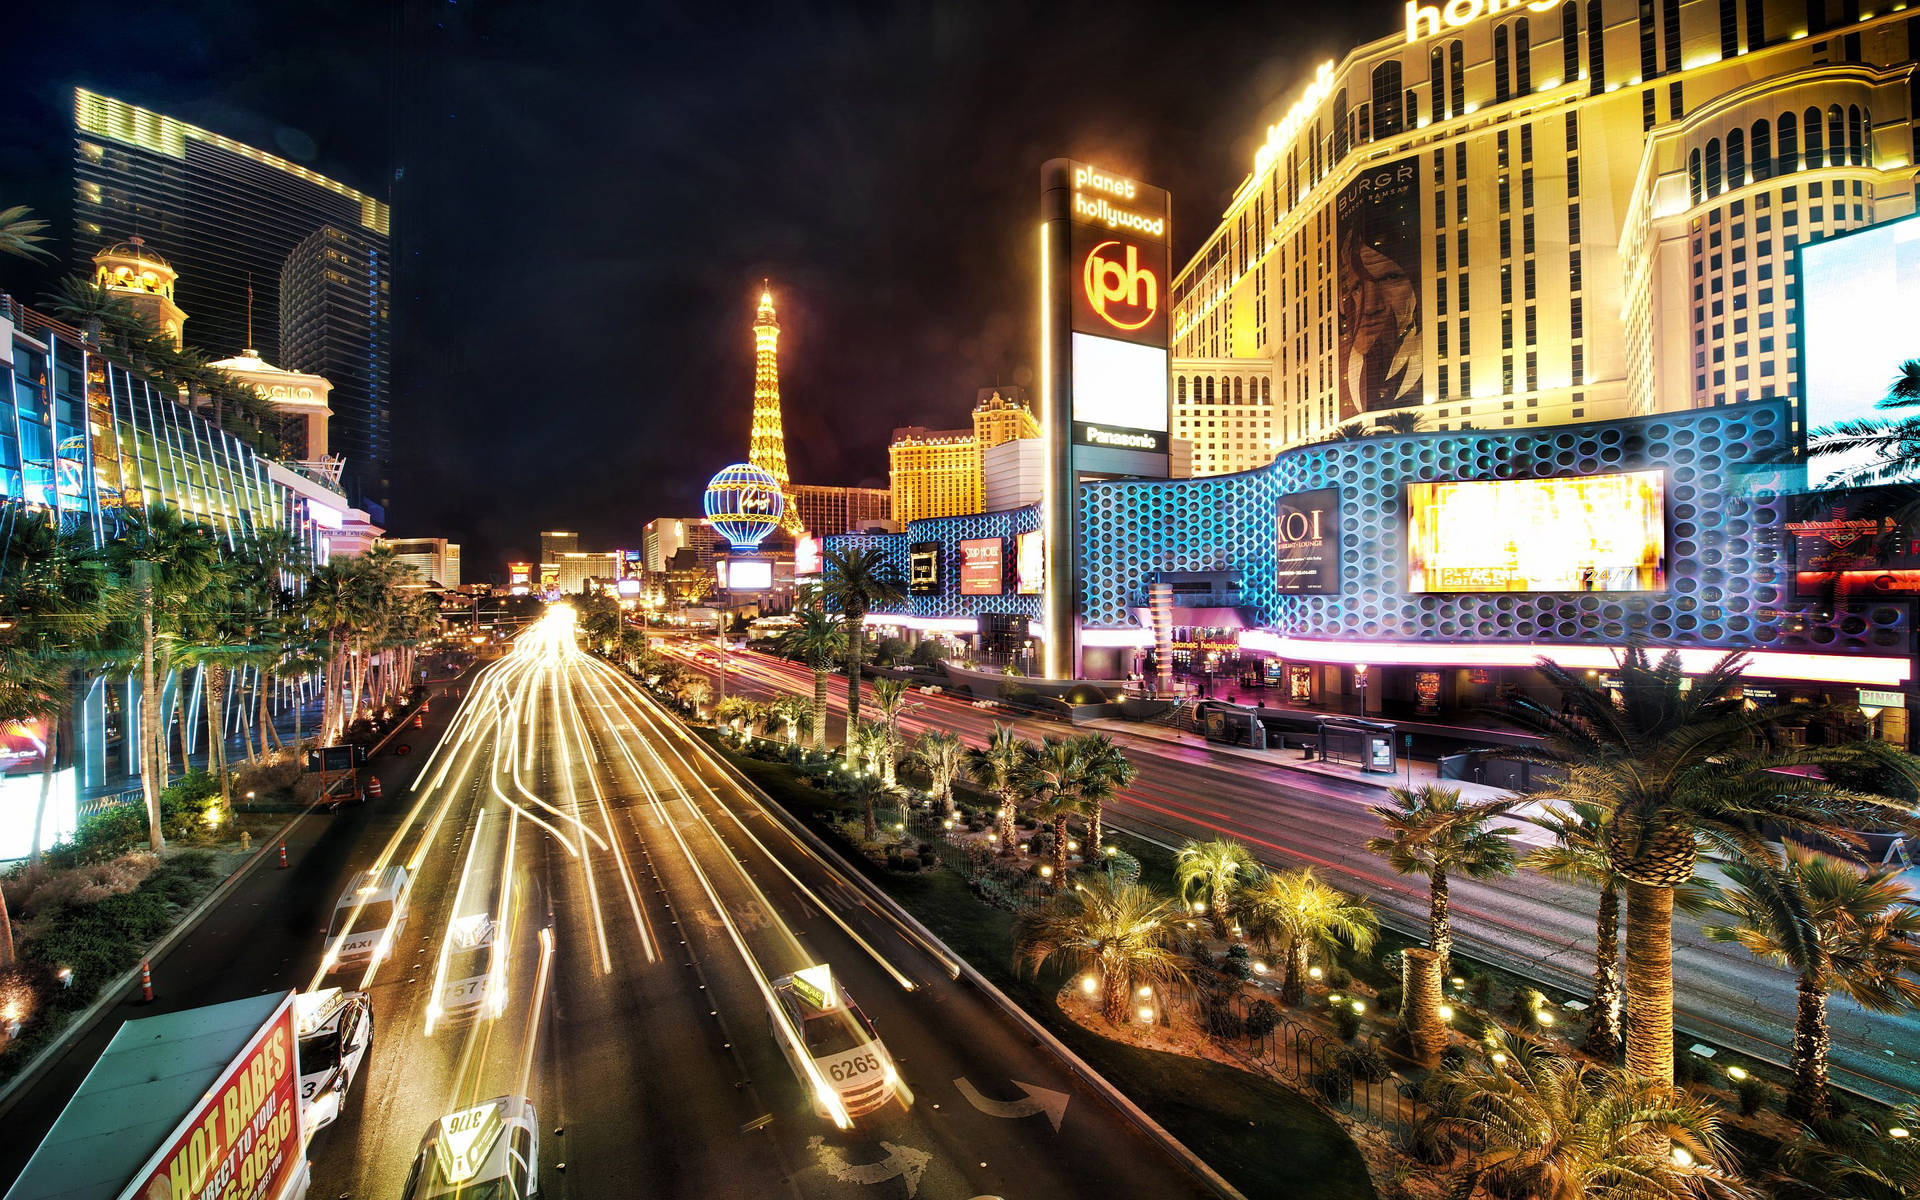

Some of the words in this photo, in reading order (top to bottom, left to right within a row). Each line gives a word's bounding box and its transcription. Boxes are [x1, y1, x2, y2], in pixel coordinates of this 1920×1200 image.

[1076, 166, 1135, 199] planet
[1338, 167, 1413, 212] BURGR
[1076, 194, 1163, 236] hollywood
[1093, 245, 1157, 315] ph
[1087, 426, 1156, 449] Panasonic
[740, 484, 770, 518] Paris
[1277, 510, 1323, 543] KOI
[1200, 640, 1239, 651] hollywoo
[341, 939, 372, 951] TAXI
[829, 1053, 880, 1082] 6265
[169, 1106, 219, 1200] HOT
[223, 1026, 286, 1151] BABES
[237, 1127, 252, 1162] TO
[252, 1091, 277, 1139] YOU!
